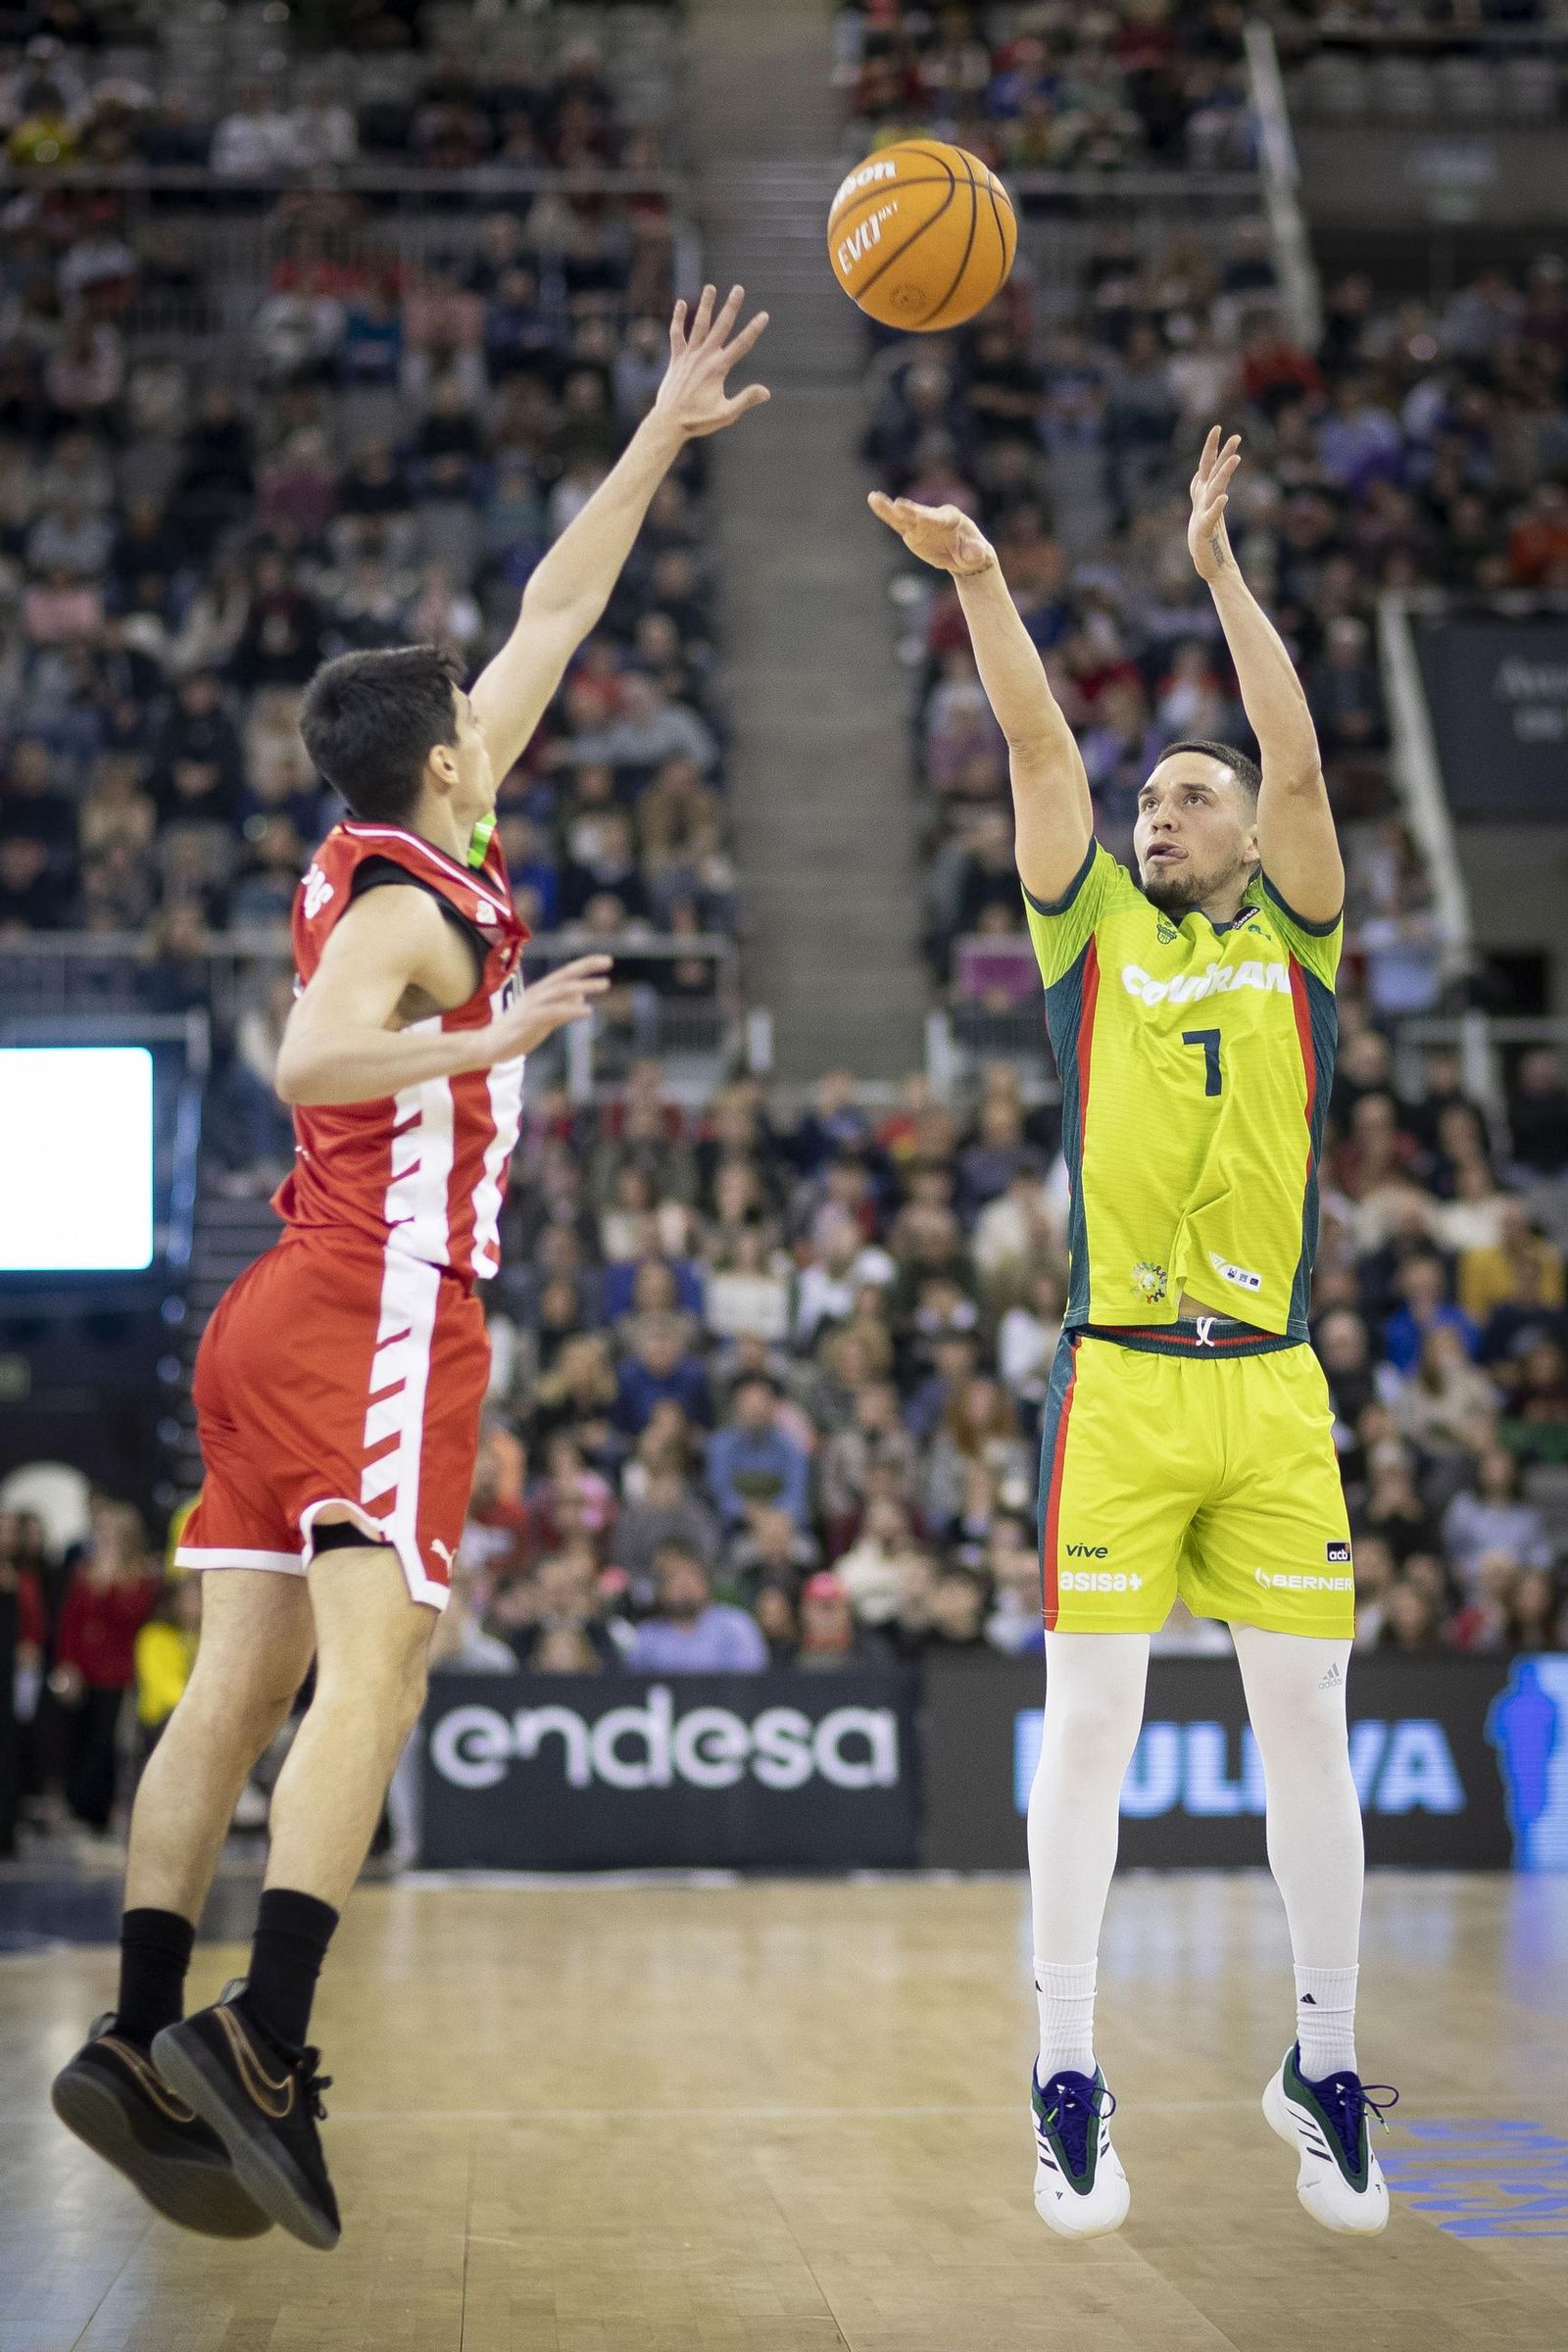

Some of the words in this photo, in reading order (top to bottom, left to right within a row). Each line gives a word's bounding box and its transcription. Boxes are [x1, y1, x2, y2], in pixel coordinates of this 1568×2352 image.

[1182, 1028, 1222, 1097] 7
[1065, 1542, 1108, 1558] vive
[1328, 1549, 1348, 1561] acb
[430, 1685, 899, 1789] endesa
